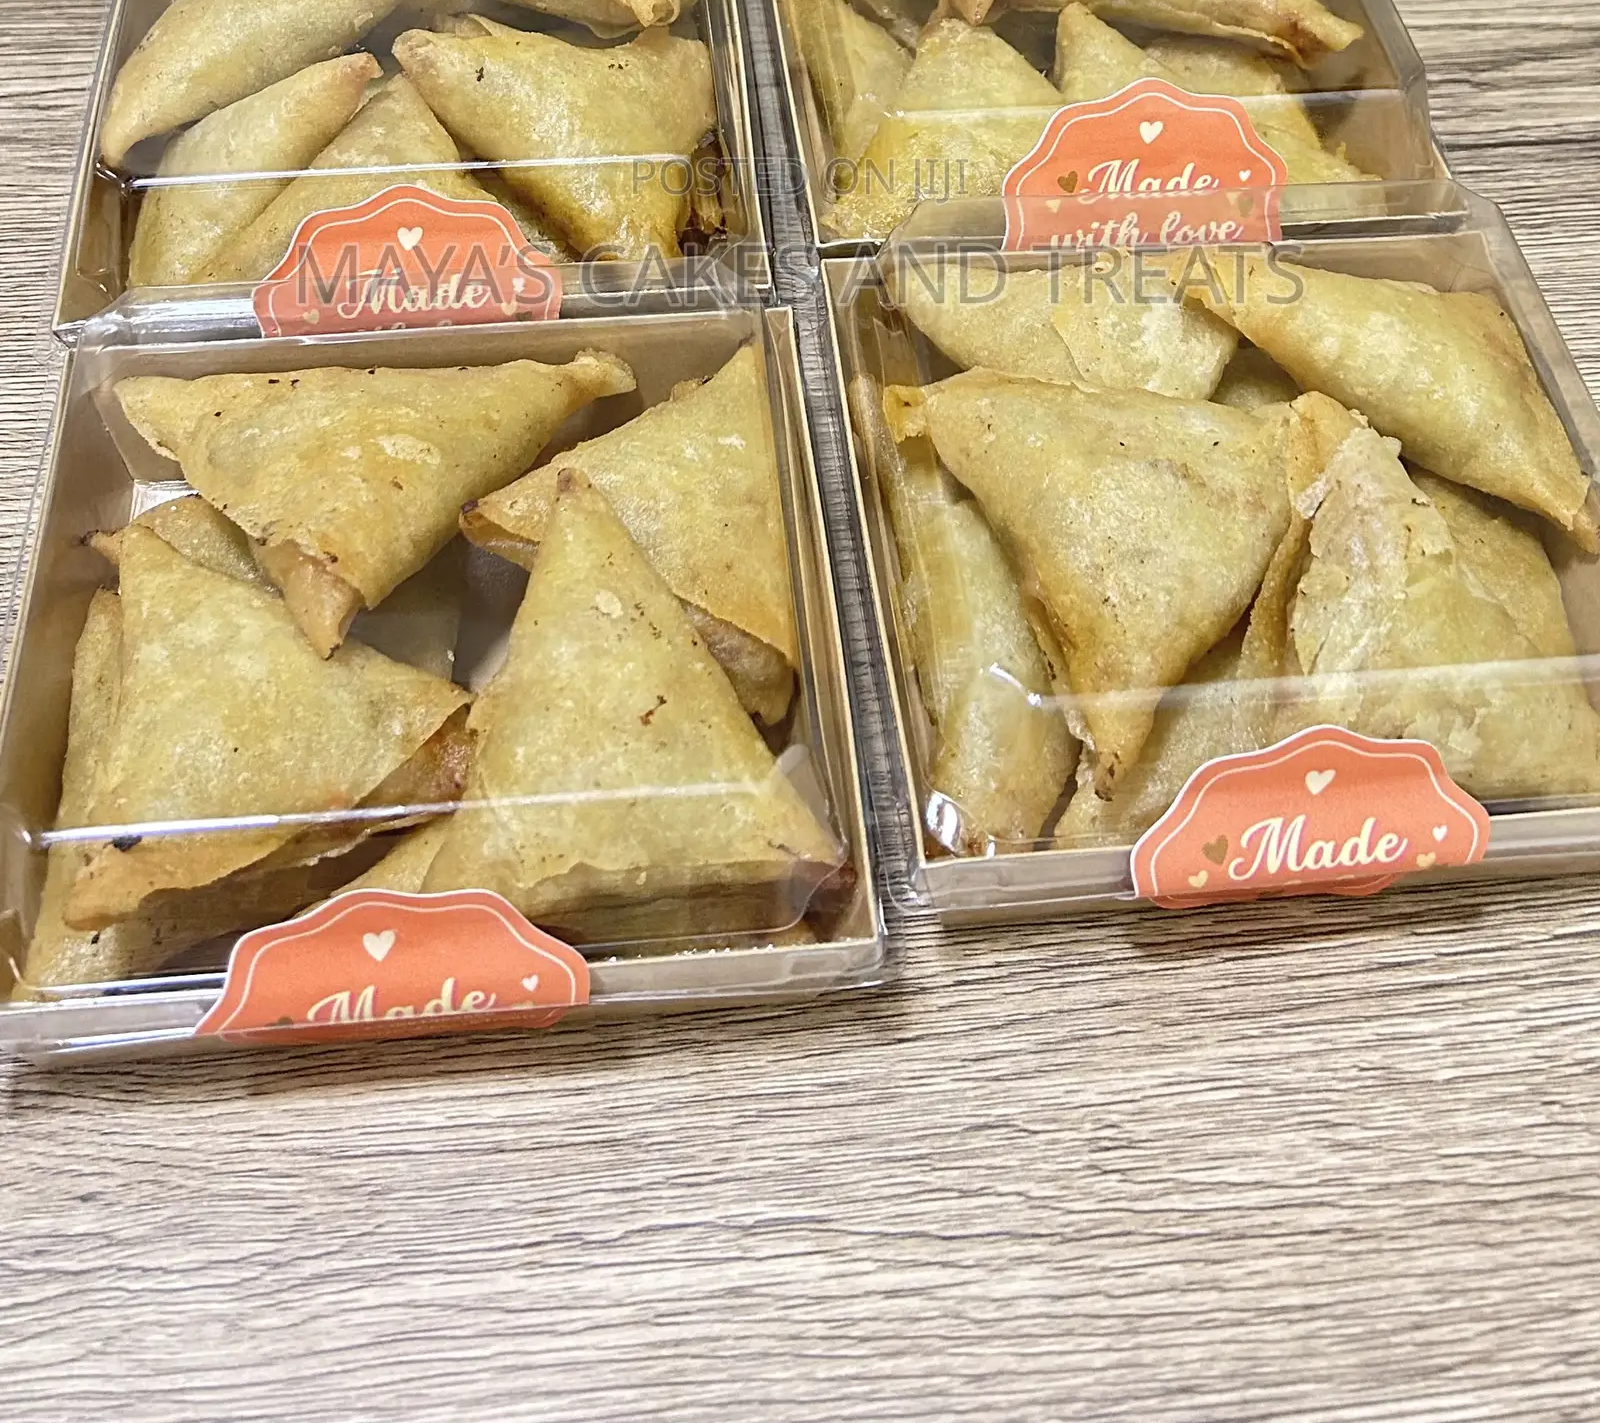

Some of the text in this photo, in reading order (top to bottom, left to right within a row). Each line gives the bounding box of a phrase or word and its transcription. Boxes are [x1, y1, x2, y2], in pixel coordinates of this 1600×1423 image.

[1077, 158, 1220, 205] Made
[1050, 210, 1244, 251] with love
[337, 266, 493, 320] Made
[1228, 814, 1408, 881] Made
